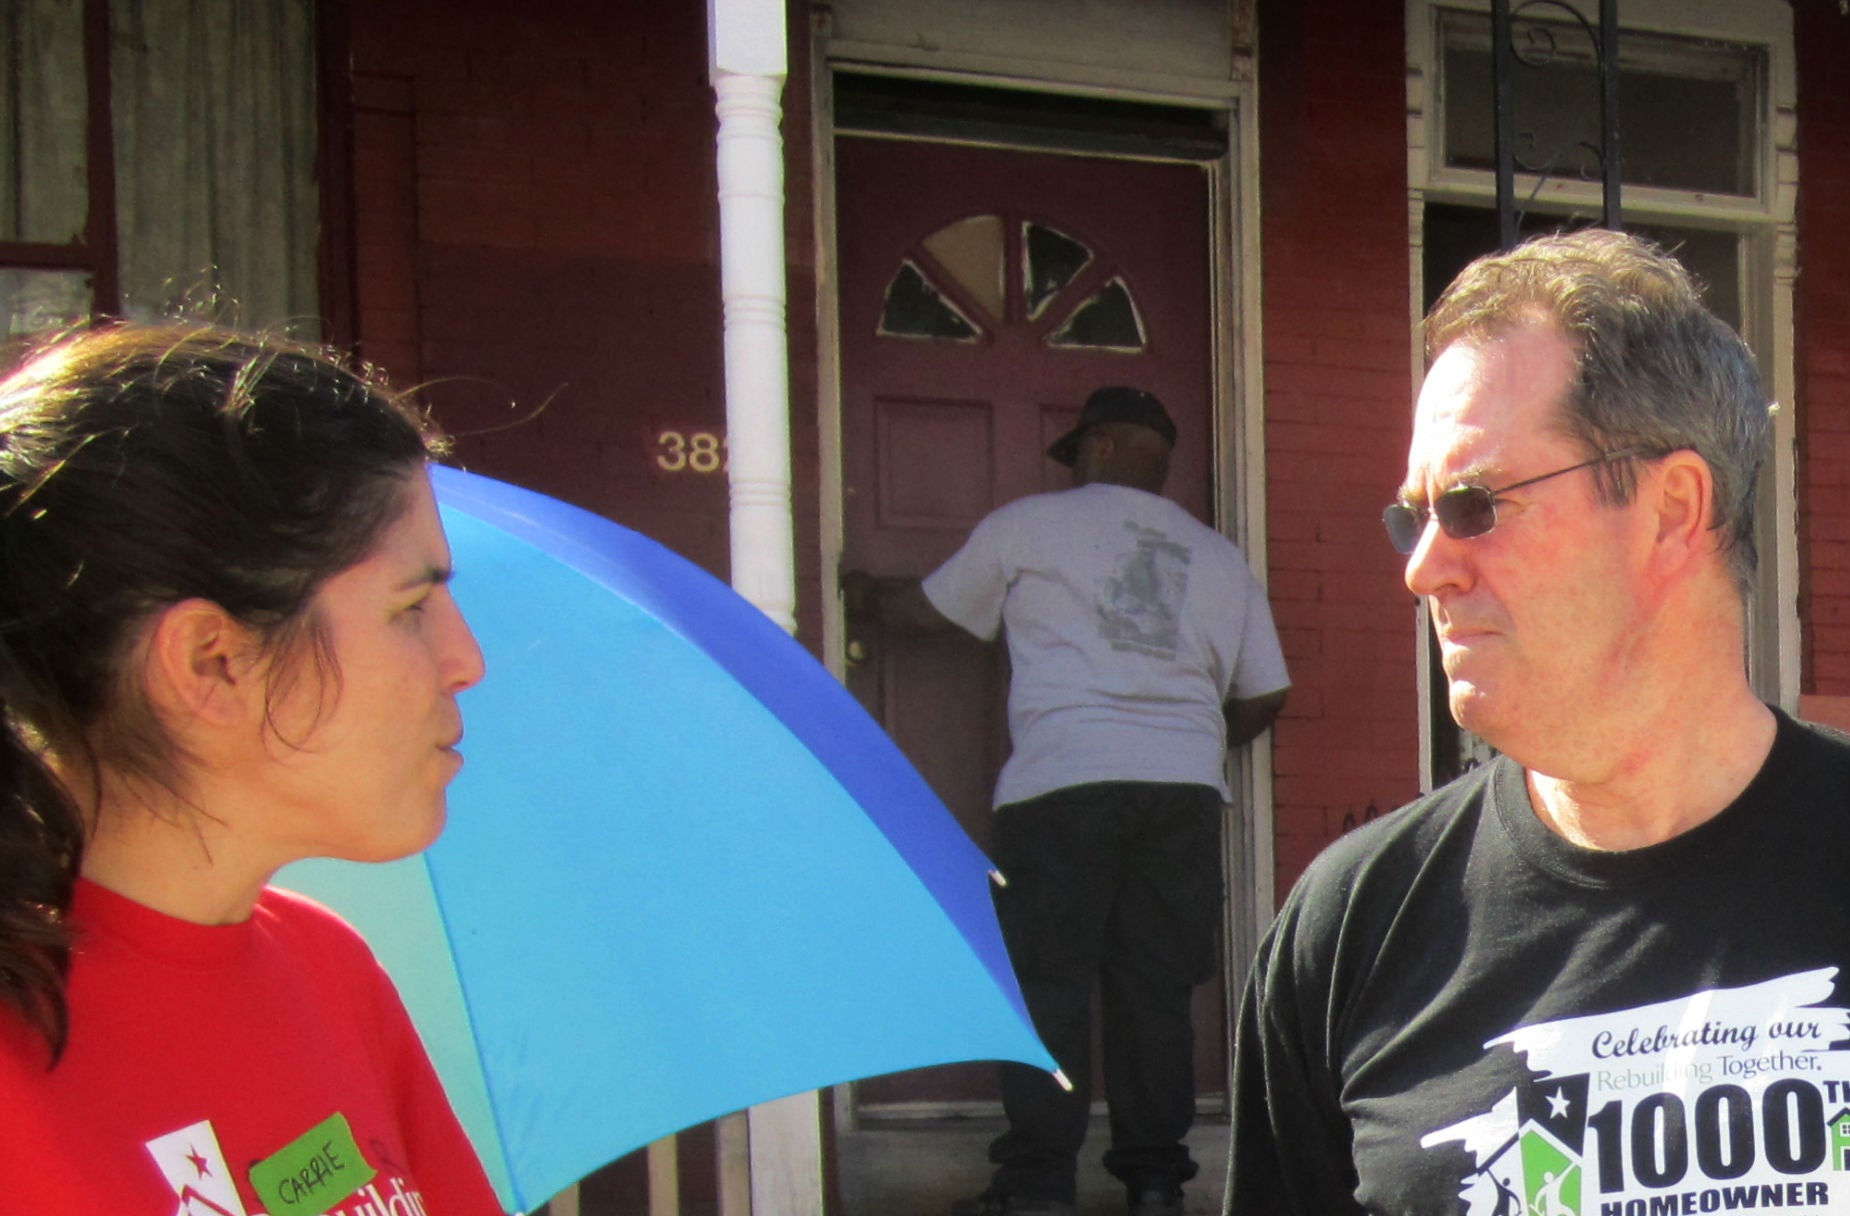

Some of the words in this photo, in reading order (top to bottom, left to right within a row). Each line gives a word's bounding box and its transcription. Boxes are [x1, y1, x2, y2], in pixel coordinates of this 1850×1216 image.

[657, 431, 728, 472] 38
[1591, 1021, 1758, 1059] Celebrating
[1768, 1021, 1822, 1040] our
[278, 1140, 345, 1205] CARRIE
